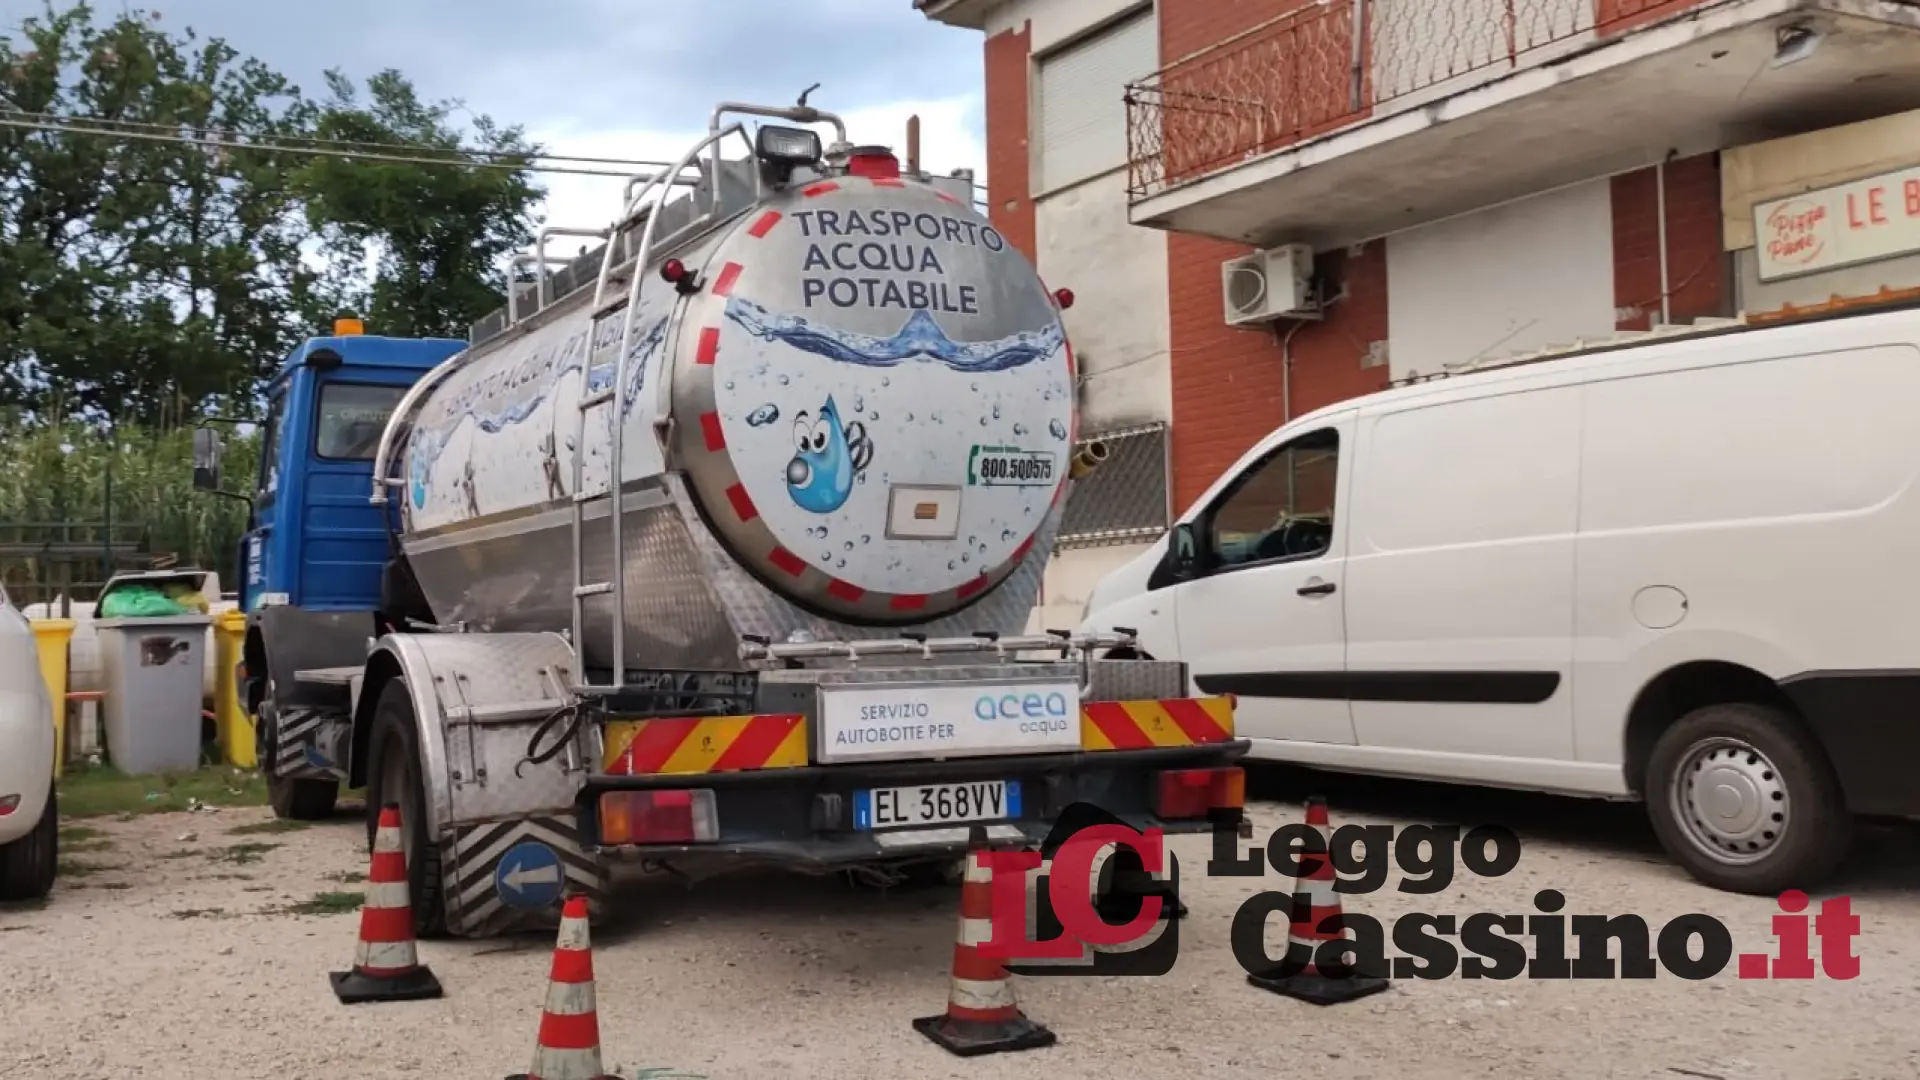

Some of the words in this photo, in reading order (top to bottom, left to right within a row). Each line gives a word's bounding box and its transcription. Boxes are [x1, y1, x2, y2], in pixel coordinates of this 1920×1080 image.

[1847, 186, 1888, 229] LE
[792, 209, 1004, 252] TRASPORTO
[803, 243, 944, 275] ACQUA
[803, 278, 979, 314] POTABILE
[981, 457, 1052, 480] 800.500575
[860, 703, 929, 720] SERVIZIO
[974, 692, 1067, 721] acea
[836, 725, 925, 745] AUTOBOTTE
[928, 724, 955, 739] PER
[1019, 720, 1068, 737] acqua
[876, 790, 909, 823] EL
[919, 783, 1002, 820] 368VV
